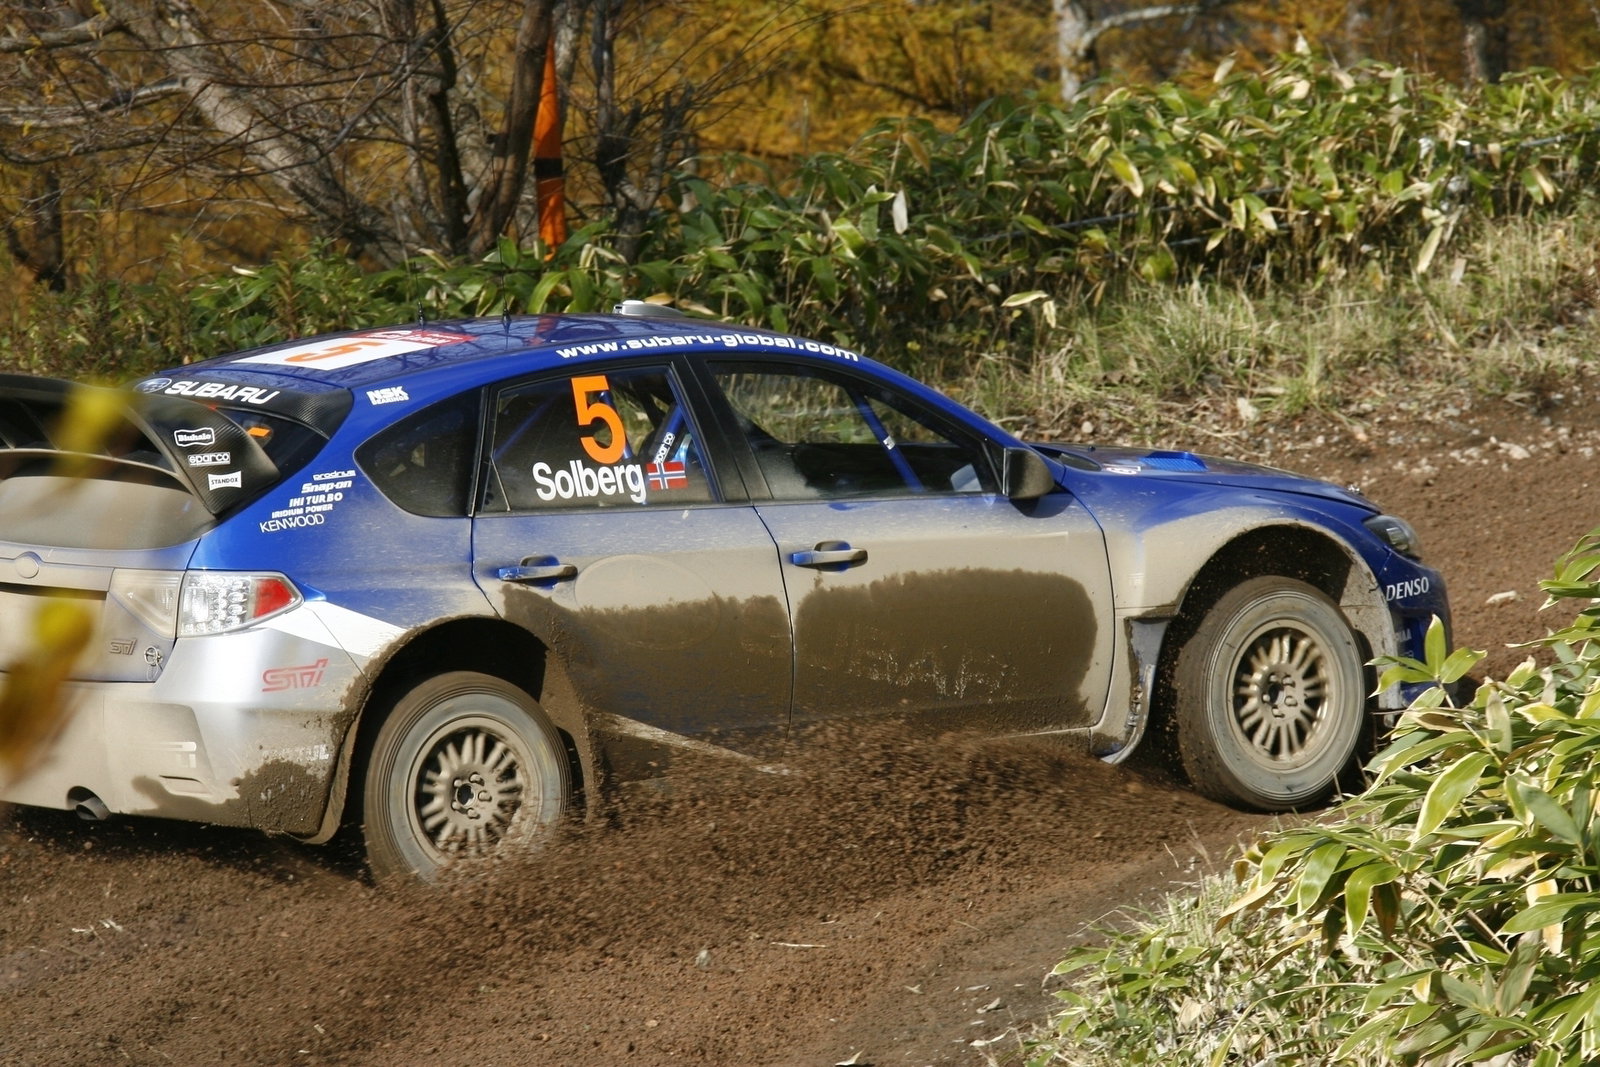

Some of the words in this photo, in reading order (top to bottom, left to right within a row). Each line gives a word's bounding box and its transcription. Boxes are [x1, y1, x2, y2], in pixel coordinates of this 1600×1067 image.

[556, 333, 859, 361] www.subaru-global.com
[164, 381, 280, 404] SUBARU
[366, 386, 408, 401] NSK
[570, 374, 627, 464] 5
[189, 453, 230, 466] sparco
[211, 477, 238, 485] STANDOX
[301, 480, 353, 493] Snap-on
[532, 459, 647, 503] Solberg
[289, 497, 304, 507] IHI
[306, 492, 343, 505] TURBO
[271, 508, 304, 519] IRIDIUM
[305, 503, 333, 513] POWER
[260, 513, 325, 533] KENWOOD
[1386, 576, 1430, 601] DENSO
